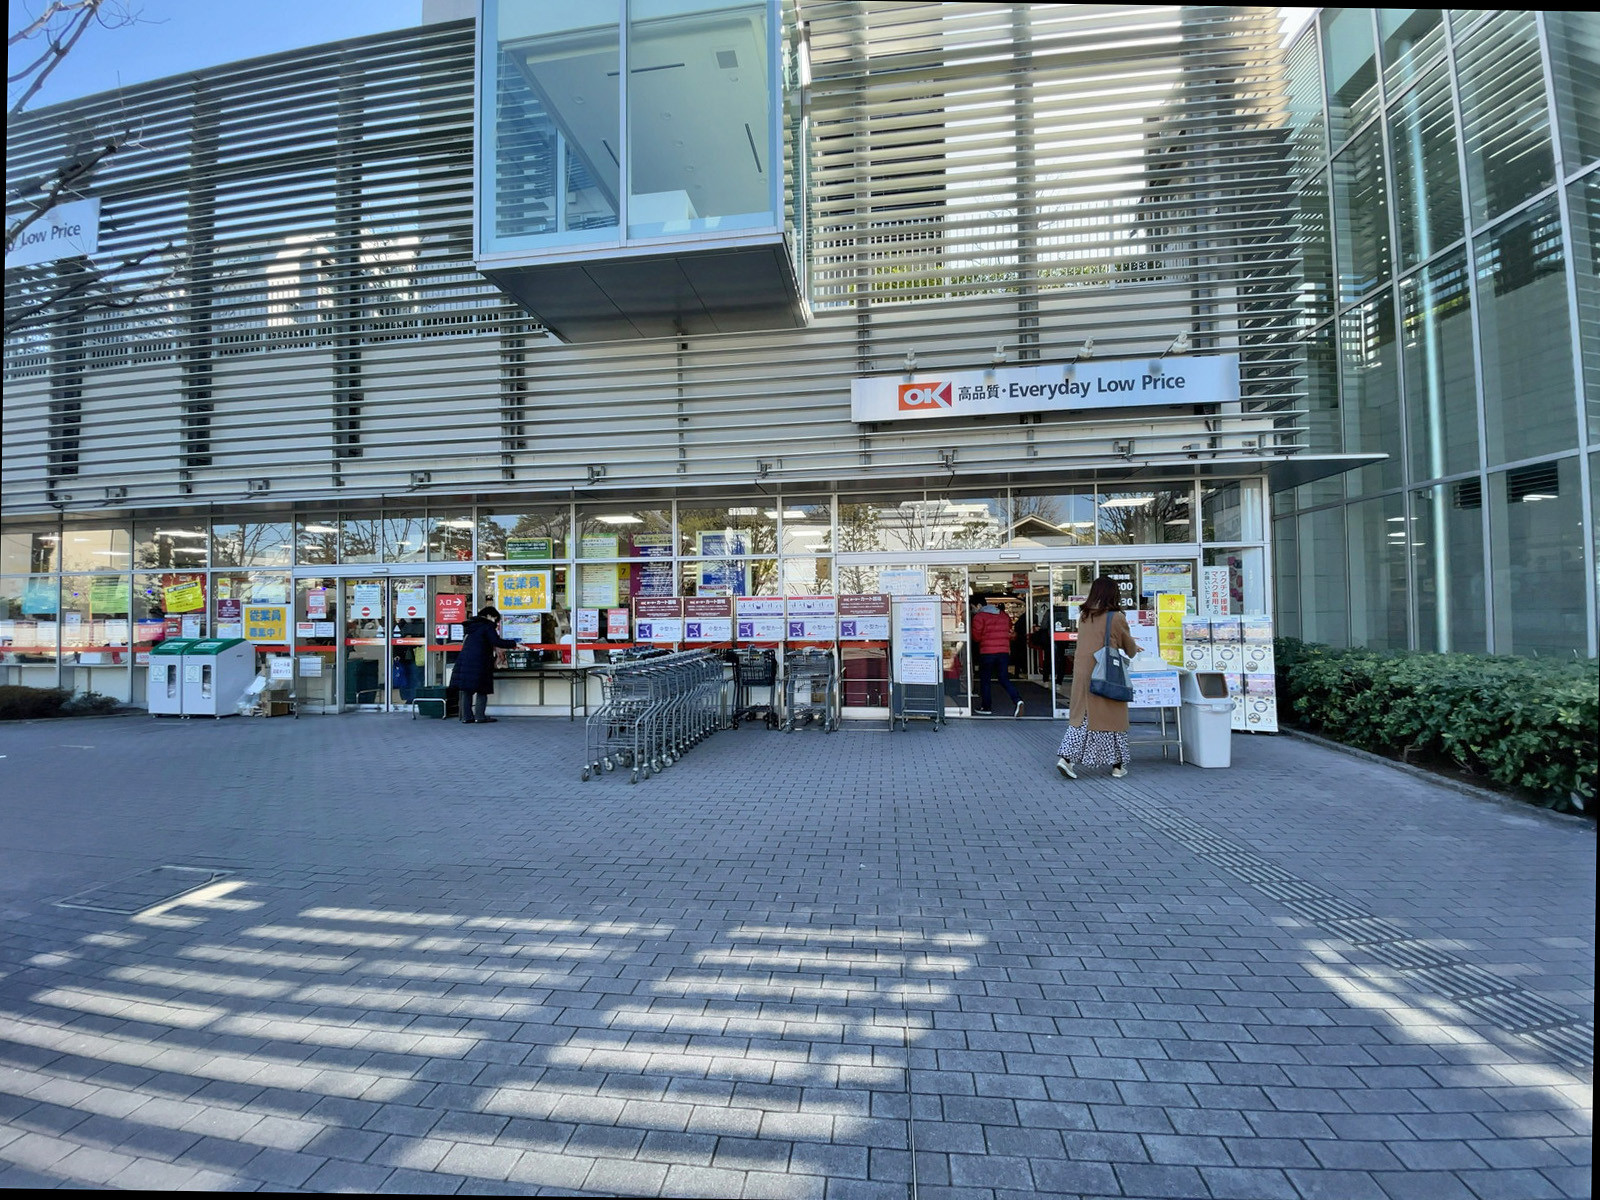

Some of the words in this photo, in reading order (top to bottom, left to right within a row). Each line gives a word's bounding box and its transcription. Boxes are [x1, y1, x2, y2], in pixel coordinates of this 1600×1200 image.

[21, 231, 47, 246] Low
[51, 222, 81, 240] Price
[900, 383, 952, 410] OK
[1097, 375, 1135, 393] Low
[1141, 372, 1186, 391] Price
[503, 576, 540, 590] 従業員
[250, 609, 281, 621] 従業員
